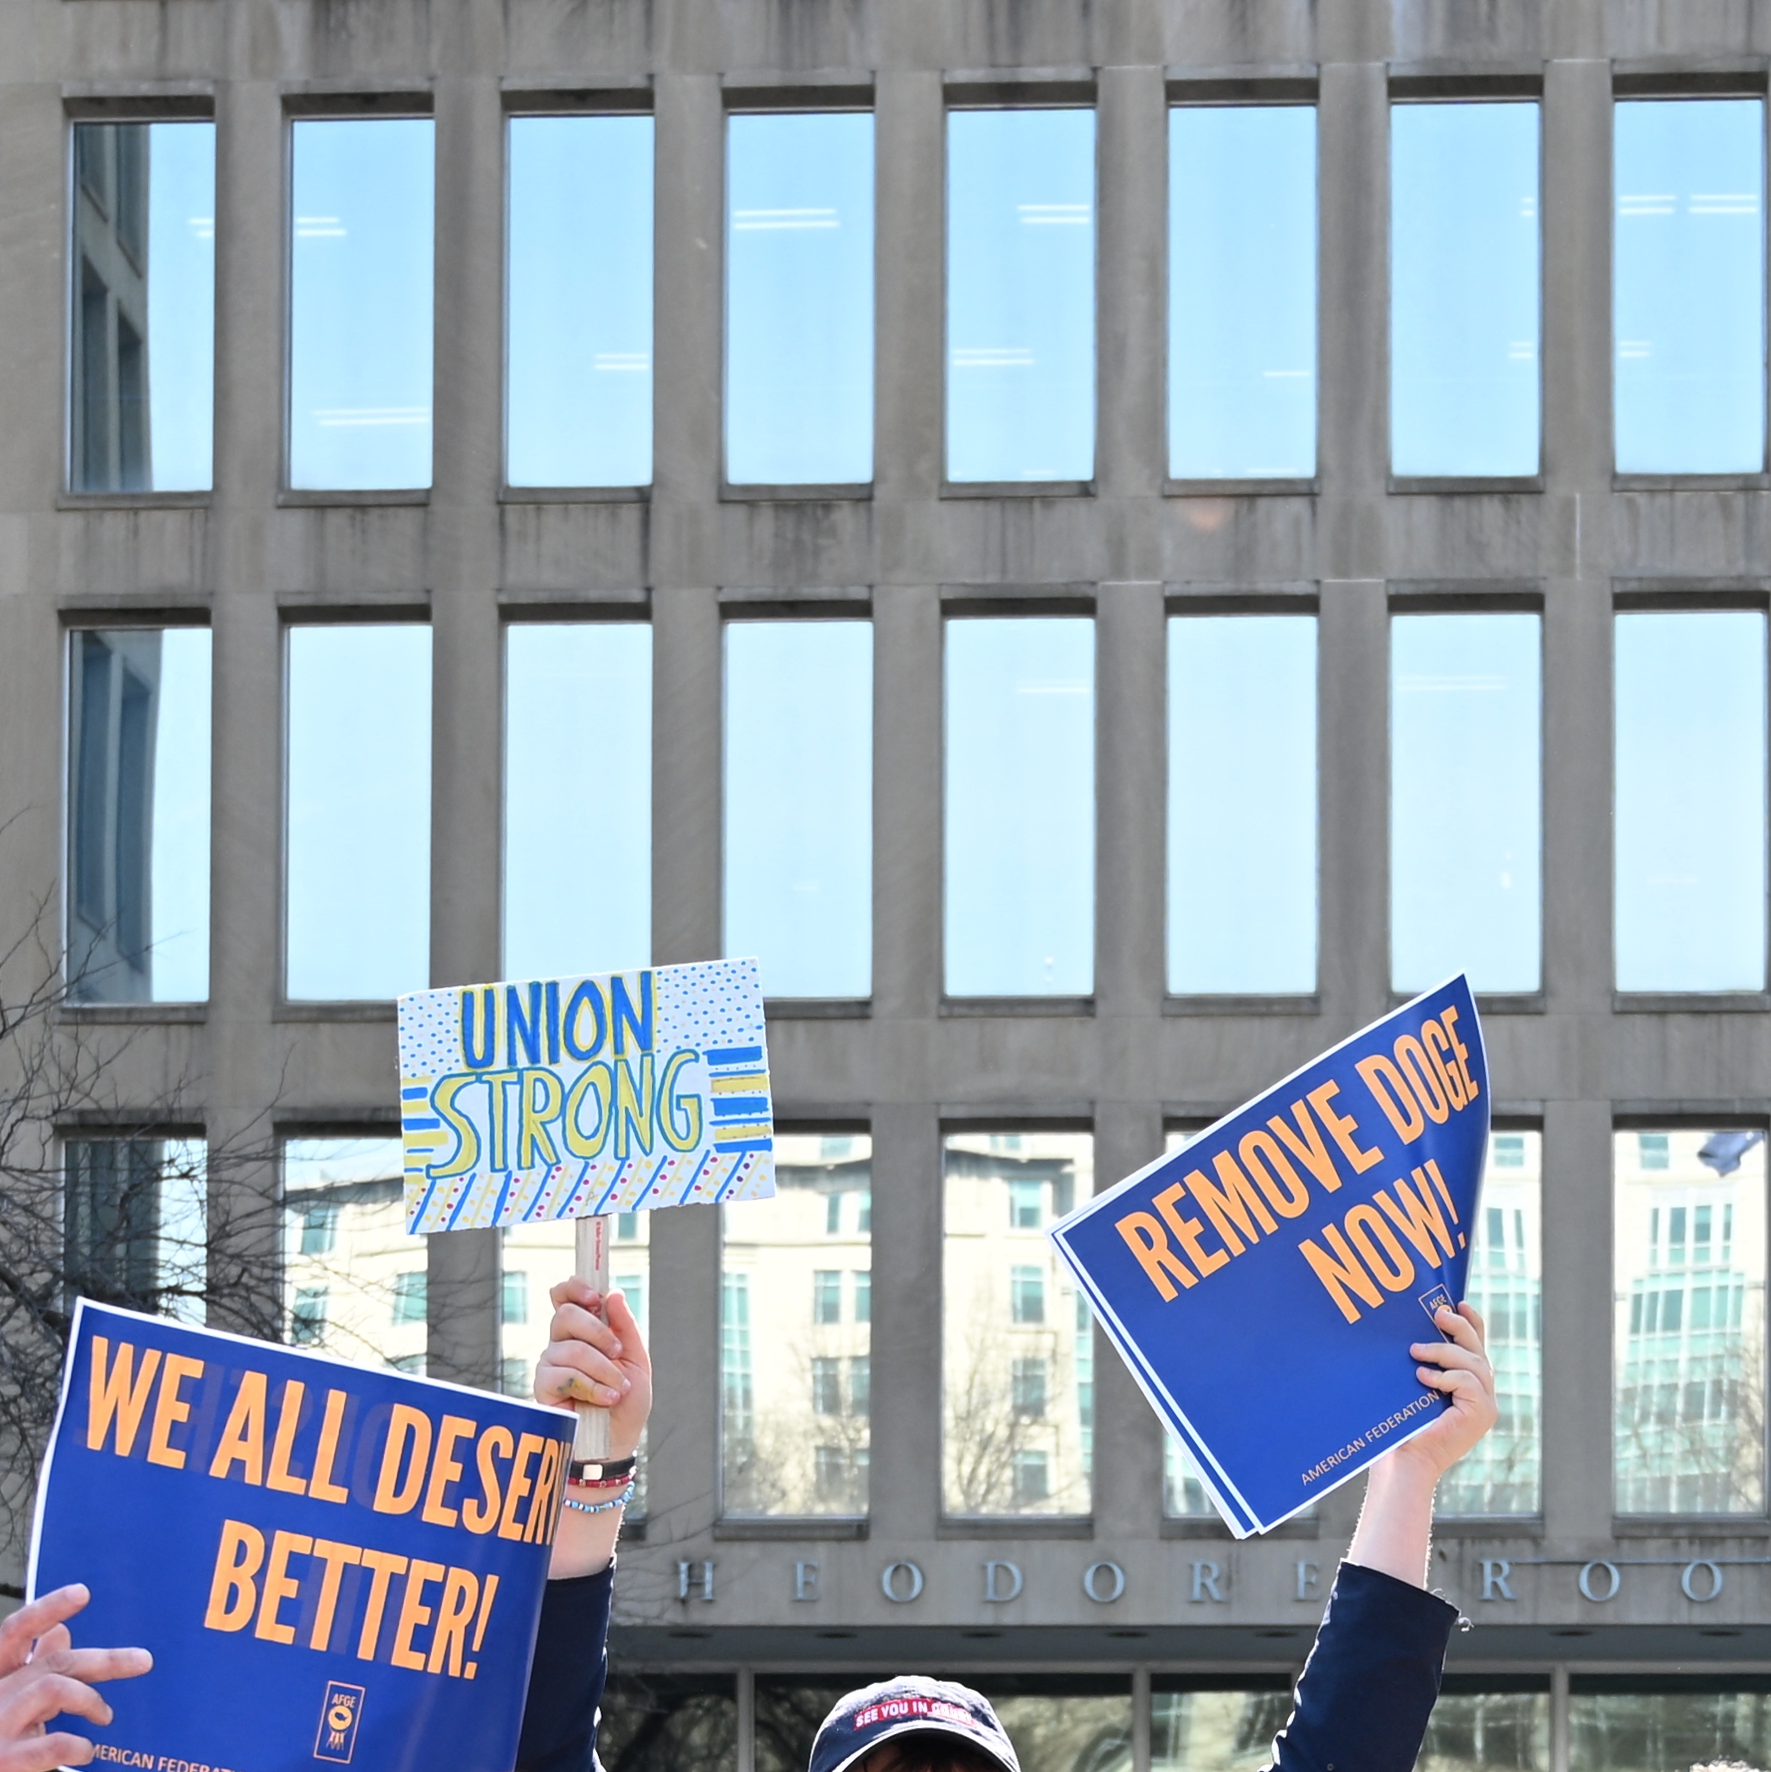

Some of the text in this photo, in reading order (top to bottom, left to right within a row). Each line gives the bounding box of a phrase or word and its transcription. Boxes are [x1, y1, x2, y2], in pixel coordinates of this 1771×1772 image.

[459, 970, 655, 1072] UNION
[427, 1048, 703, 1180] STRONG
[1114, 1004, 1480, 1303] REMOVE DOGE
[1297, 1158, 1467, 1325] NOW!
[87, 1335, 206, 1470] WE
[209, 1369, 350, 1507] ALL
[1300, 1389, 1441, 1487] AMERICAN FEDERATION
[204, 1519, 499, 1680] BETTER!
[677, 1560, 1321, 1602] HEODORE
[331, 1693, 357, 1709] AFGE
[855, 1708, 879, 1728] SEE
[881, 1702, 908, 1718] YOU
[912, 1701, 928, 1713] IN
[90, 1743, 155, 1772] MERICAN
